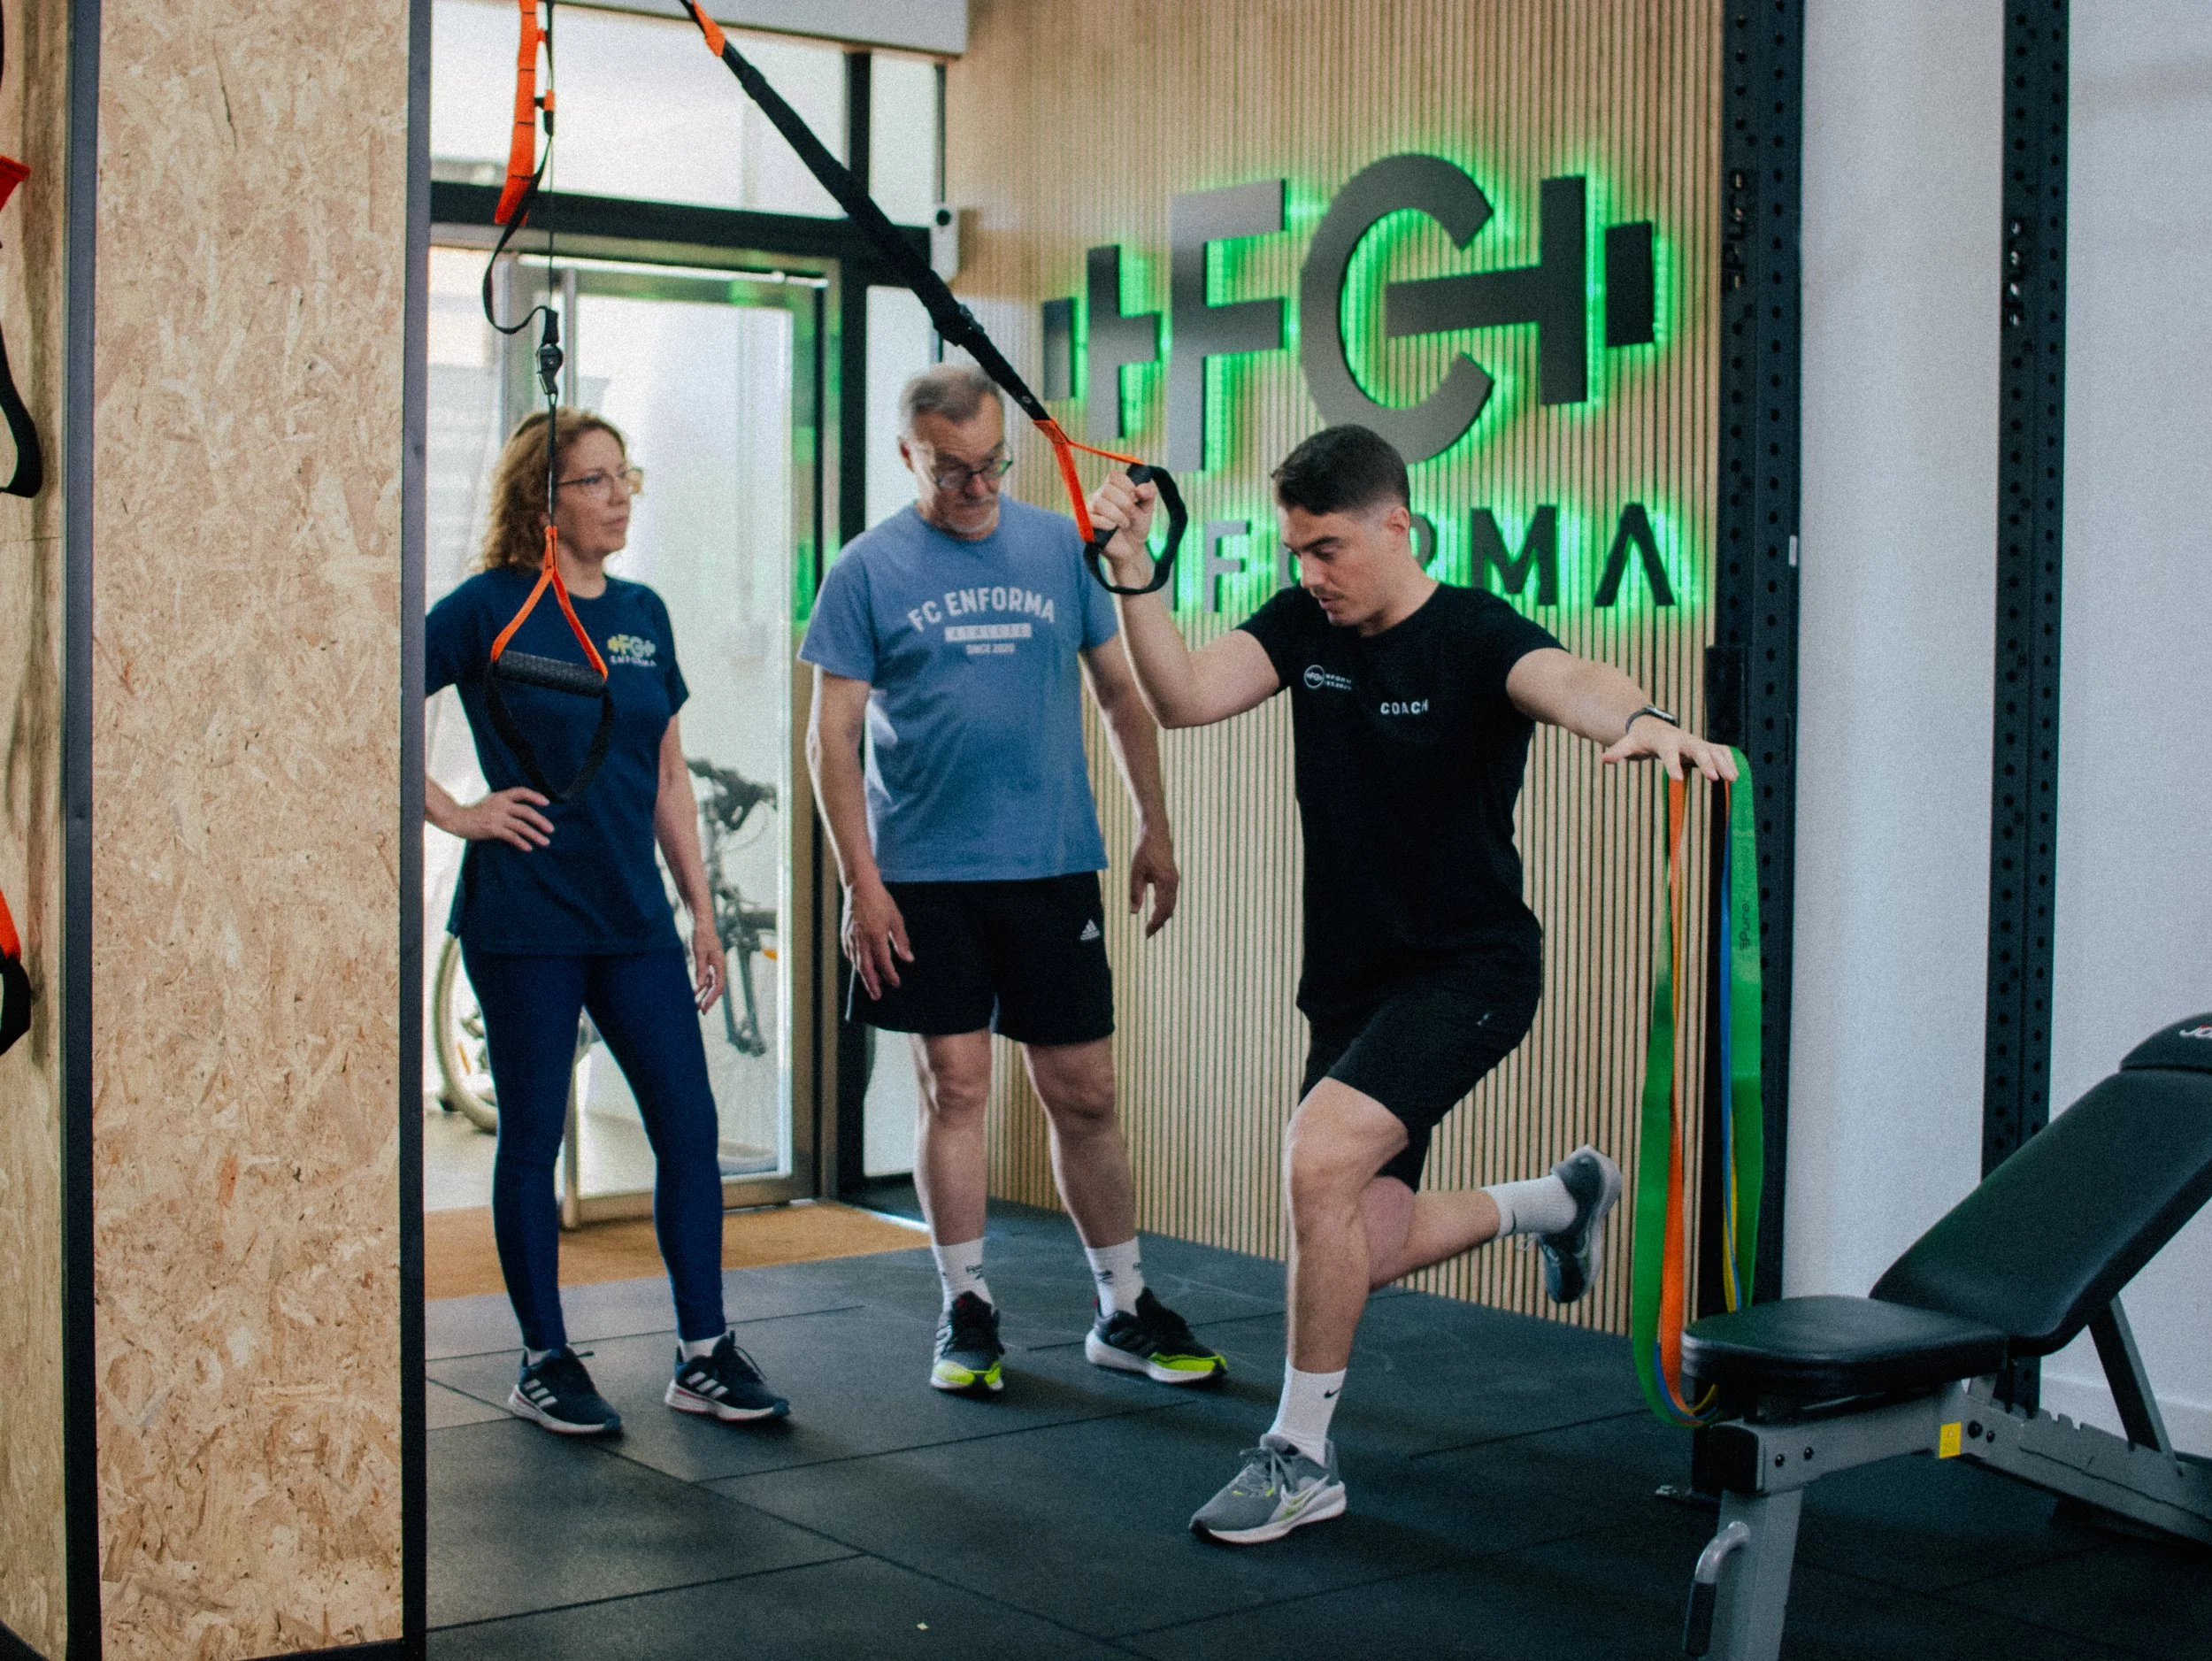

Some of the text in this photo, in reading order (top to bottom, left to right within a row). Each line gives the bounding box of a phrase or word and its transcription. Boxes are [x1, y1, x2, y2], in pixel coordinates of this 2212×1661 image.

[907, 600, 942, 633] FC
[944, 586, 1056, 624] ENFORMA
[1380, 698, 1429, 715] COACH
